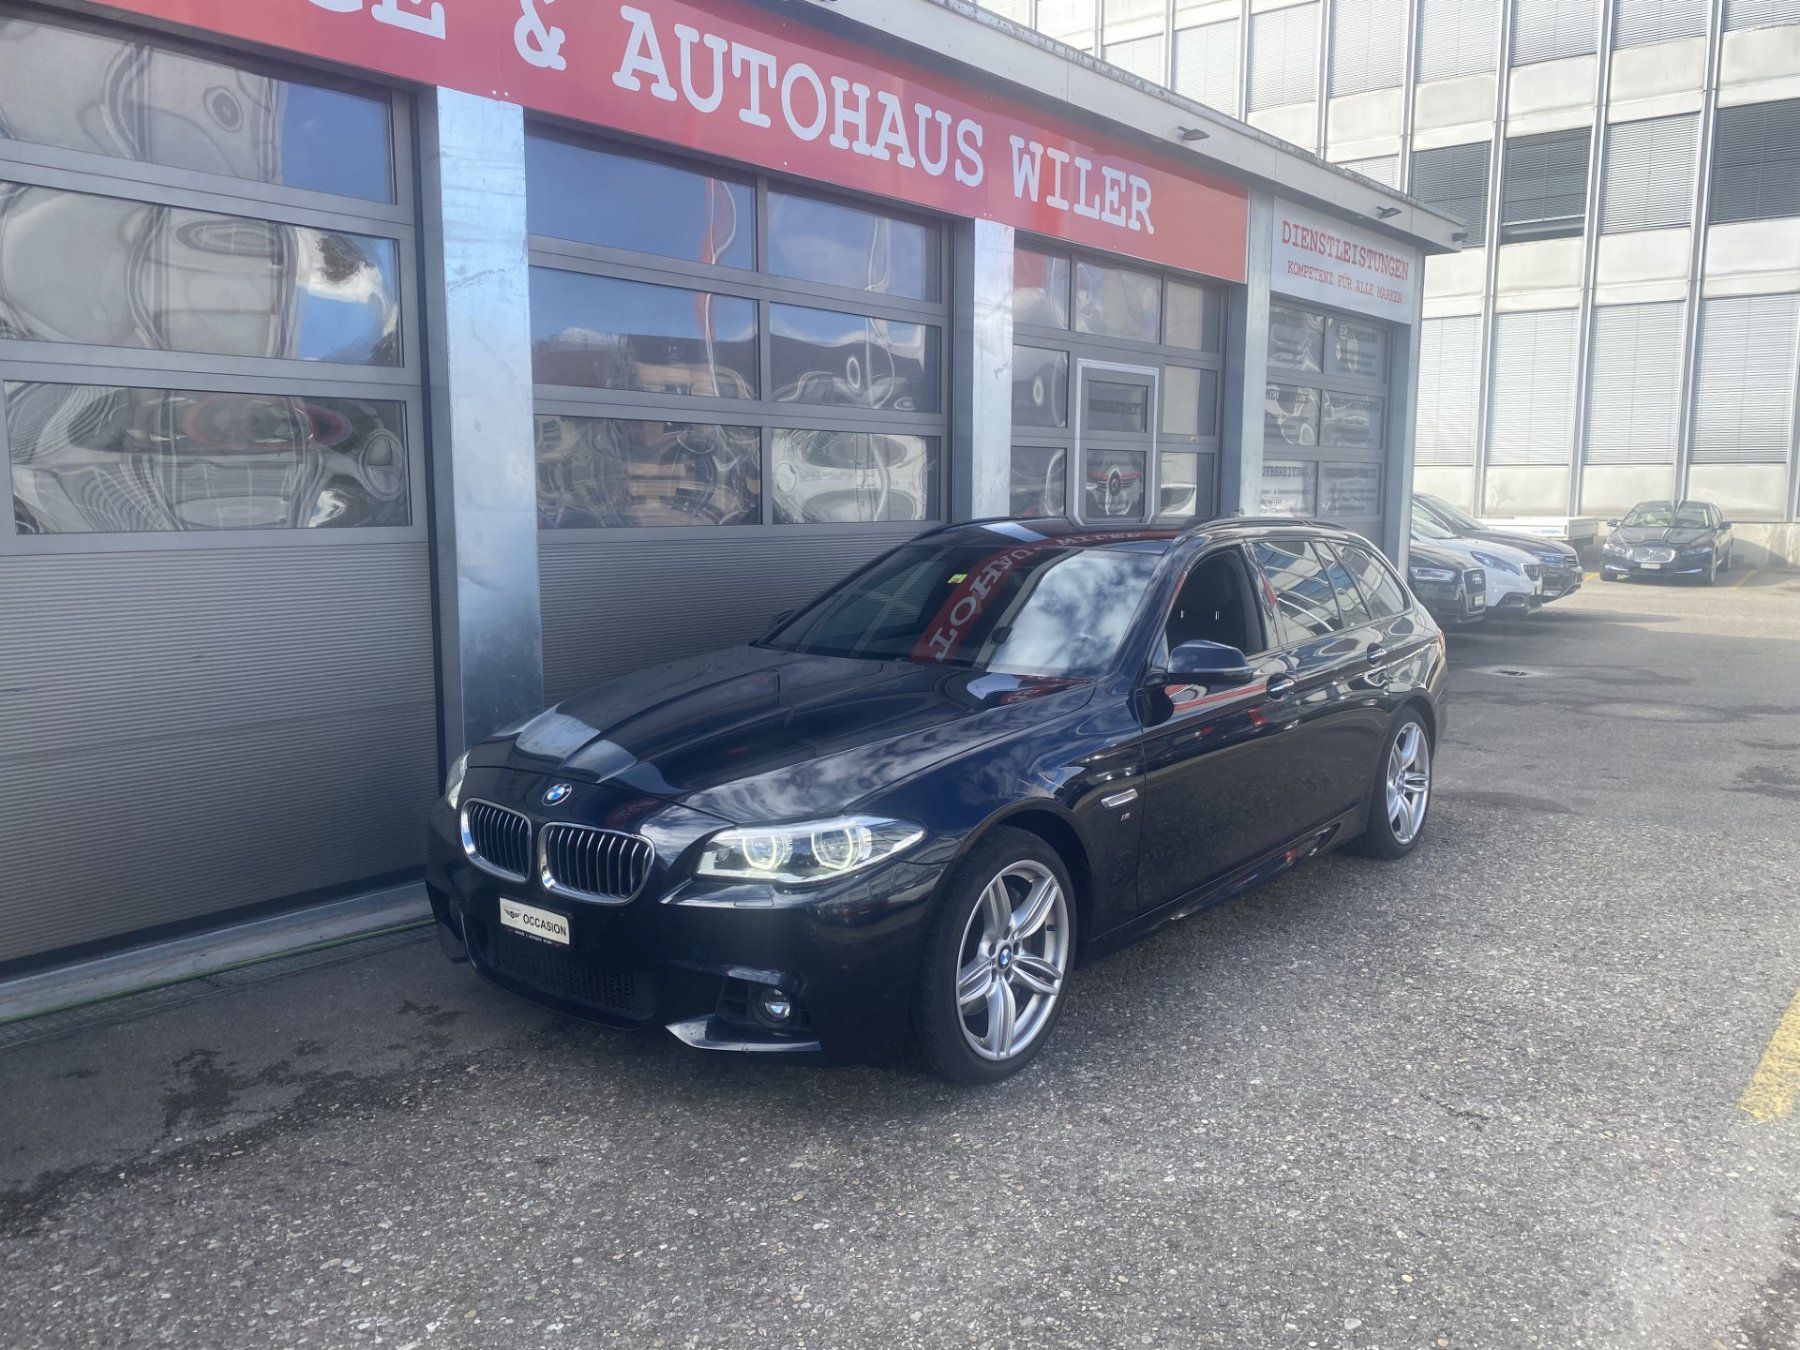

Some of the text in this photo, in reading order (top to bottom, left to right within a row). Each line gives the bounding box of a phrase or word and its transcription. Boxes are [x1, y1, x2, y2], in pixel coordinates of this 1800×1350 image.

[513, 0, 567, 71] &
[612, 4, 985, 187] AUTOHAUS
[1009, 134, 1155, 235] WILER
[1282, 220, 1410, 281] DIENSTLEISTUNGEN
[1287, 259, 1403, 304] KOMPETENZ FÜR ALLE MARKEN
[523, 913, 567, 936] OCCASION
